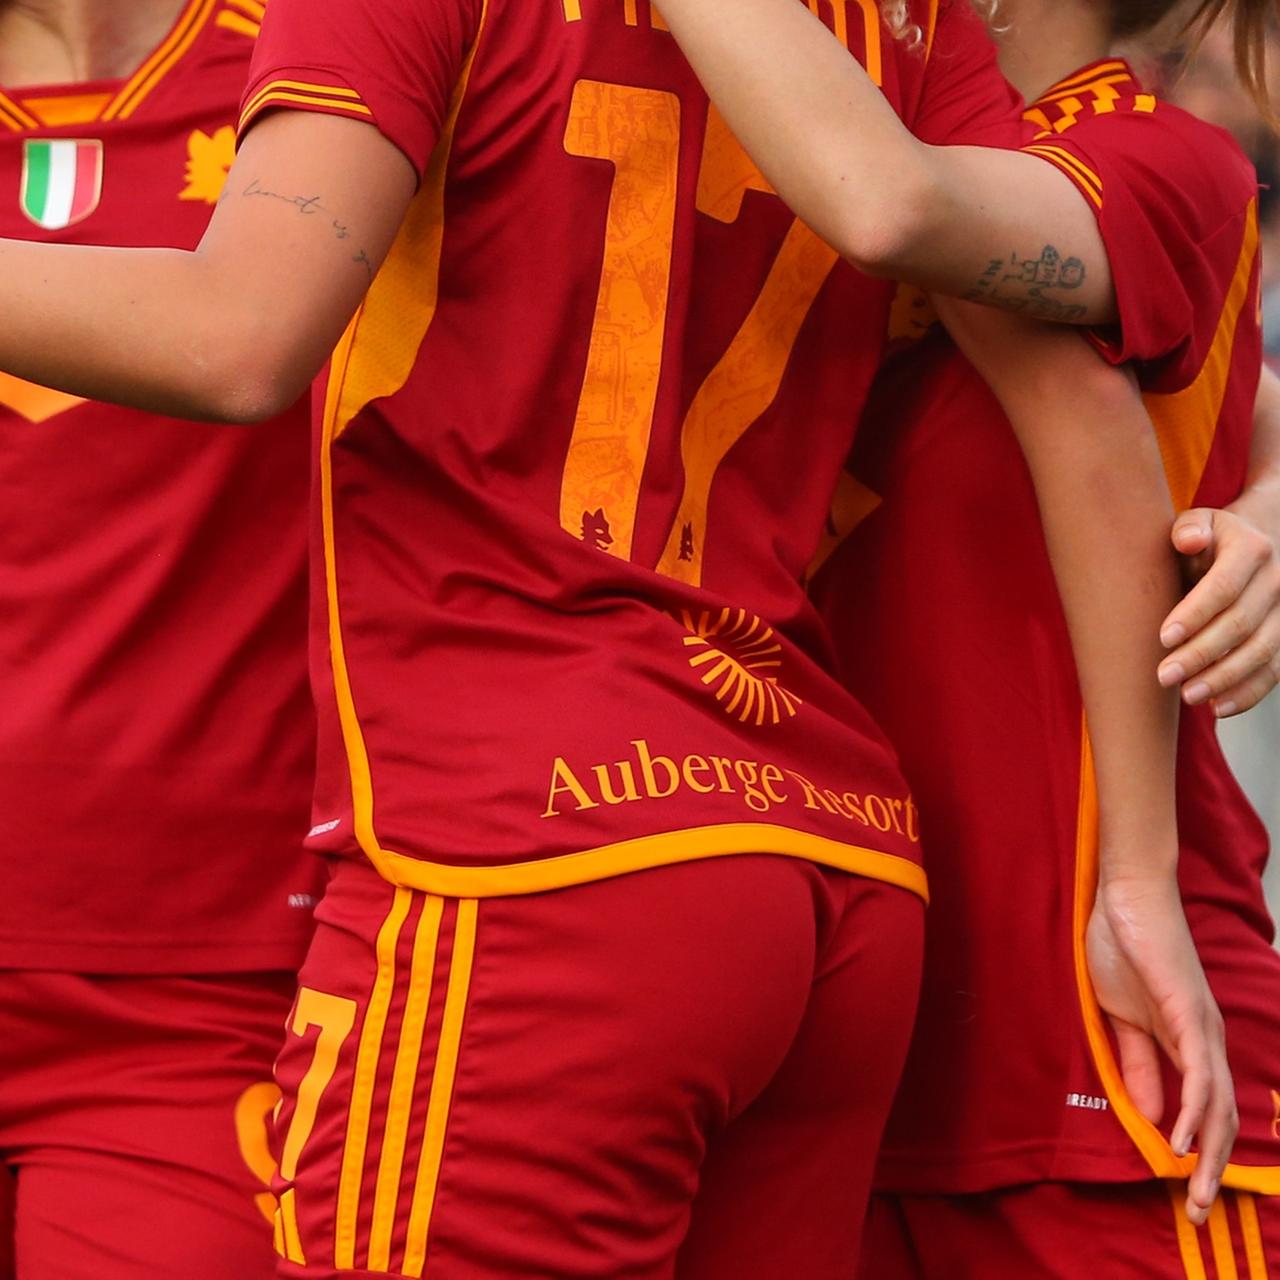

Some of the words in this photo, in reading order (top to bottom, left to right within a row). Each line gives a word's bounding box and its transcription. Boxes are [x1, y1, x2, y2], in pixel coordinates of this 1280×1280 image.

[540, 739, 789, 818] Auberge
[273, 986, 358, 1182] 7
[1066, 1093, 1108, 1110] READY
